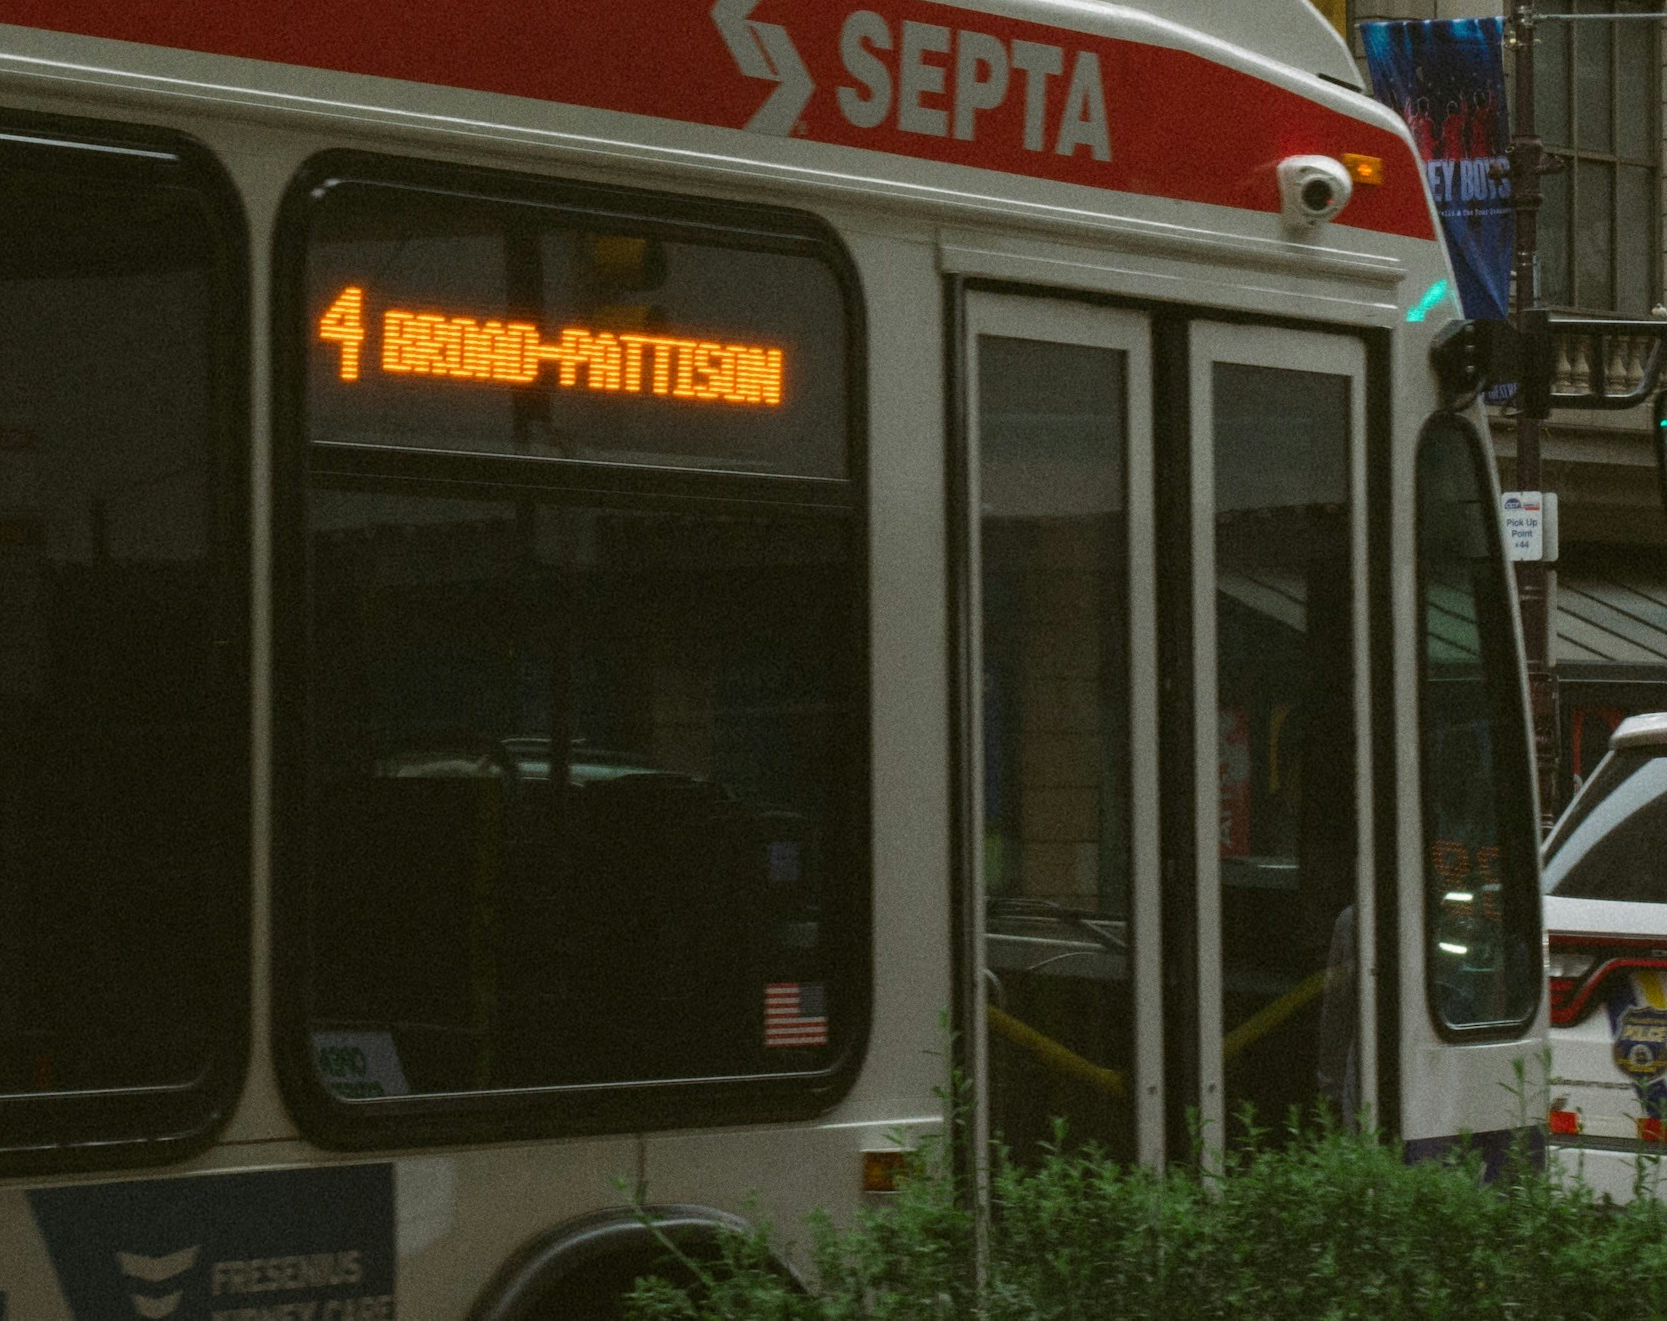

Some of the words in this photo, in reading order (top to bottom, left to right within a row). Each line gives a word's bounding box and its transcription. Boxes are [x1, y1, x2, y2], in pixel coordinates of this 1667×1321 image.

[835, 10, 1113, 163] SEPTA
[320, 286, 365, 382] 4
[381, 310, 784, 406] BROAD-PATTISON
[1506, 518, 1524, 527] Pick
[1526, 518, 1538, 528] Up
[1511, 529, 1533, 538] Point
